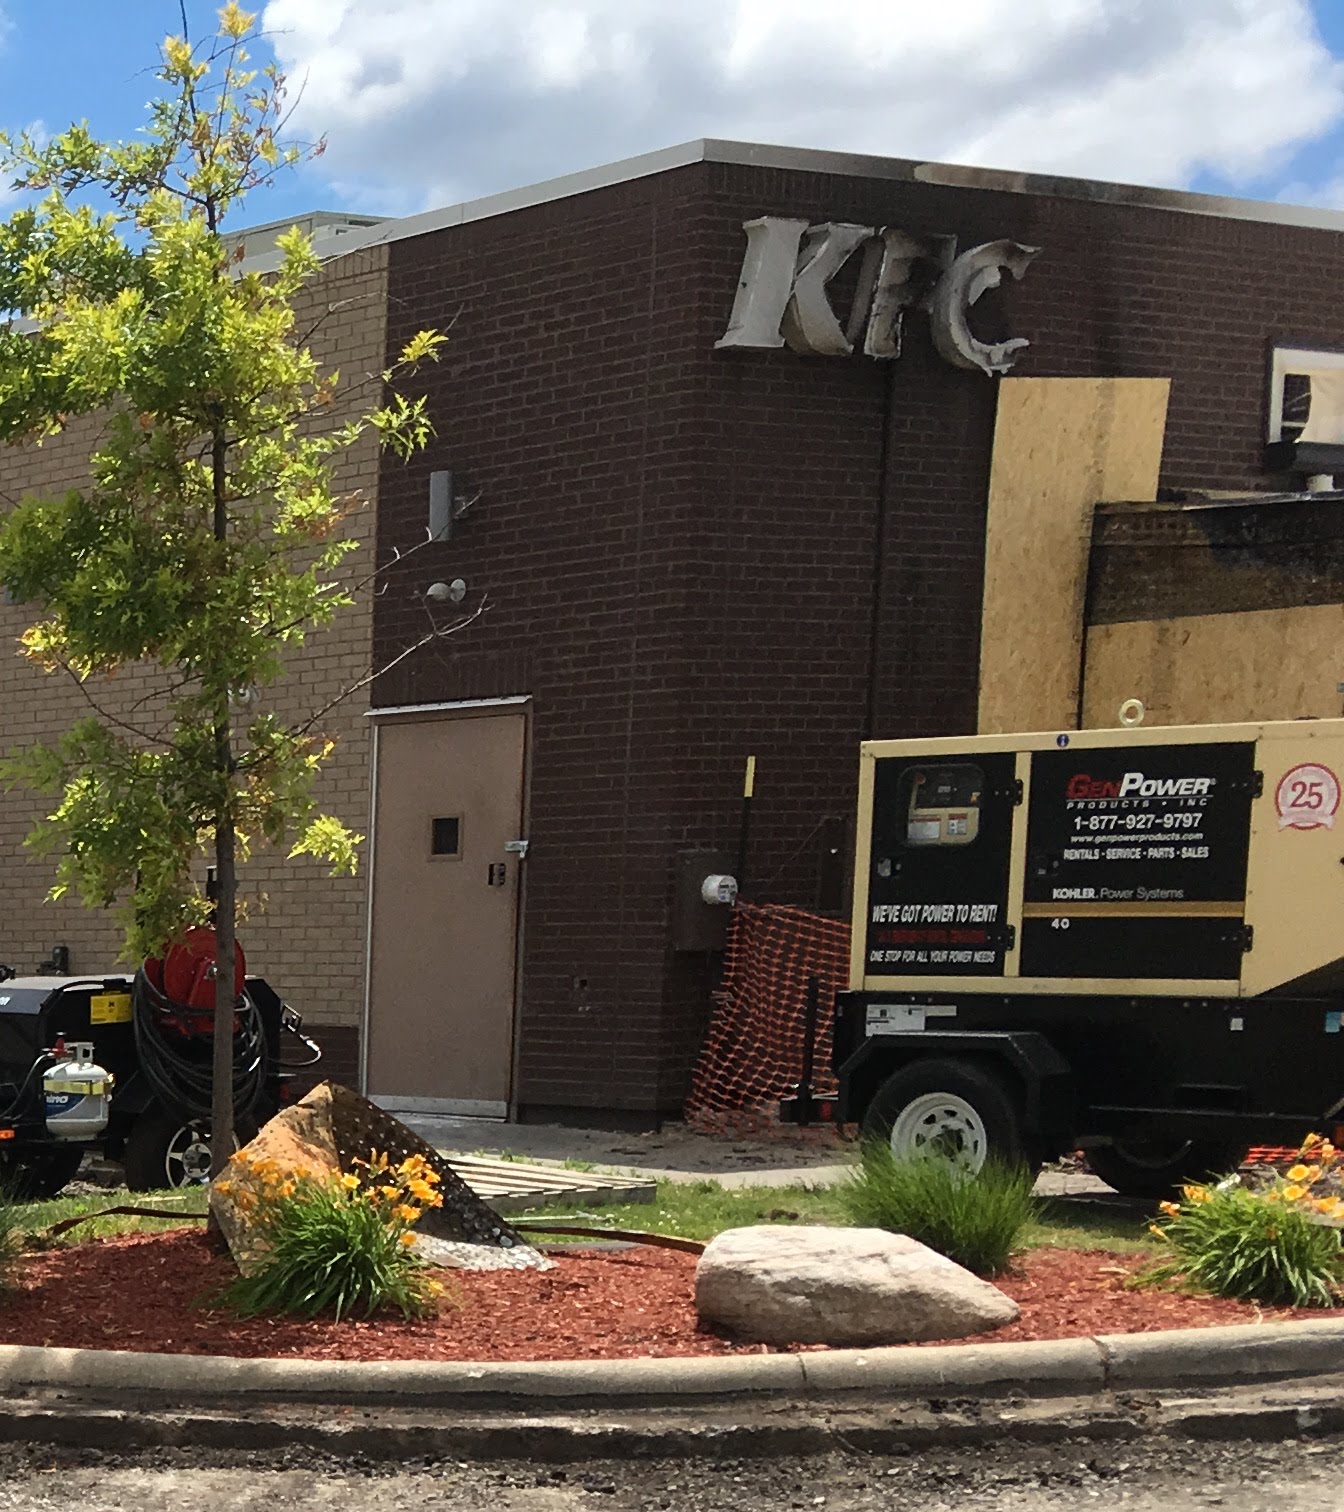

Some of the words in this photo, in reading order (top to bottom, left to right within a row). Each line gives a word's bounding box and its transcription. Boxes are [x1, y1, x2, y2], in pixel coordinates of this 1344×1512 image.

[714, 216, 1043, 377] KFC
[1289, 781, 1324, 809] 25
[1066, 800, 1150, 810] PRODUCTS
[1179, 798, 1208, 807] INC
[1074, 813, 1203, 830] 1-877-927-9797
[1070, 832, 1204, 844] www.genpowerproducts.com
[1063, 849, 1100, 860] RENTALS
[1106, 848, 1142, 860] SERVICE
[1147, 847, 1175, 859] PARTS
[1181, 846, 1209, 858] SALES
[1100, 887, 1134, 899] Power
[1136, 886, 1184, 901] Systems
[900, 904, 921, 922] GOT
[921, 904, 954, 922] POWER
[956, 904, 969, 922] TO
[1051, 918, 1070, 929] 40
[870, 950, 884, 962] ONE
[884, 950, 902, 962] STOP
[902, 951, 915, 962] FOR
[916, 951, 928, 962] ALL
[930, 951, 948, 962] YOUR
[948, 951, 972, 962] POWER
[973, 951, 996, 963] NEEDS
